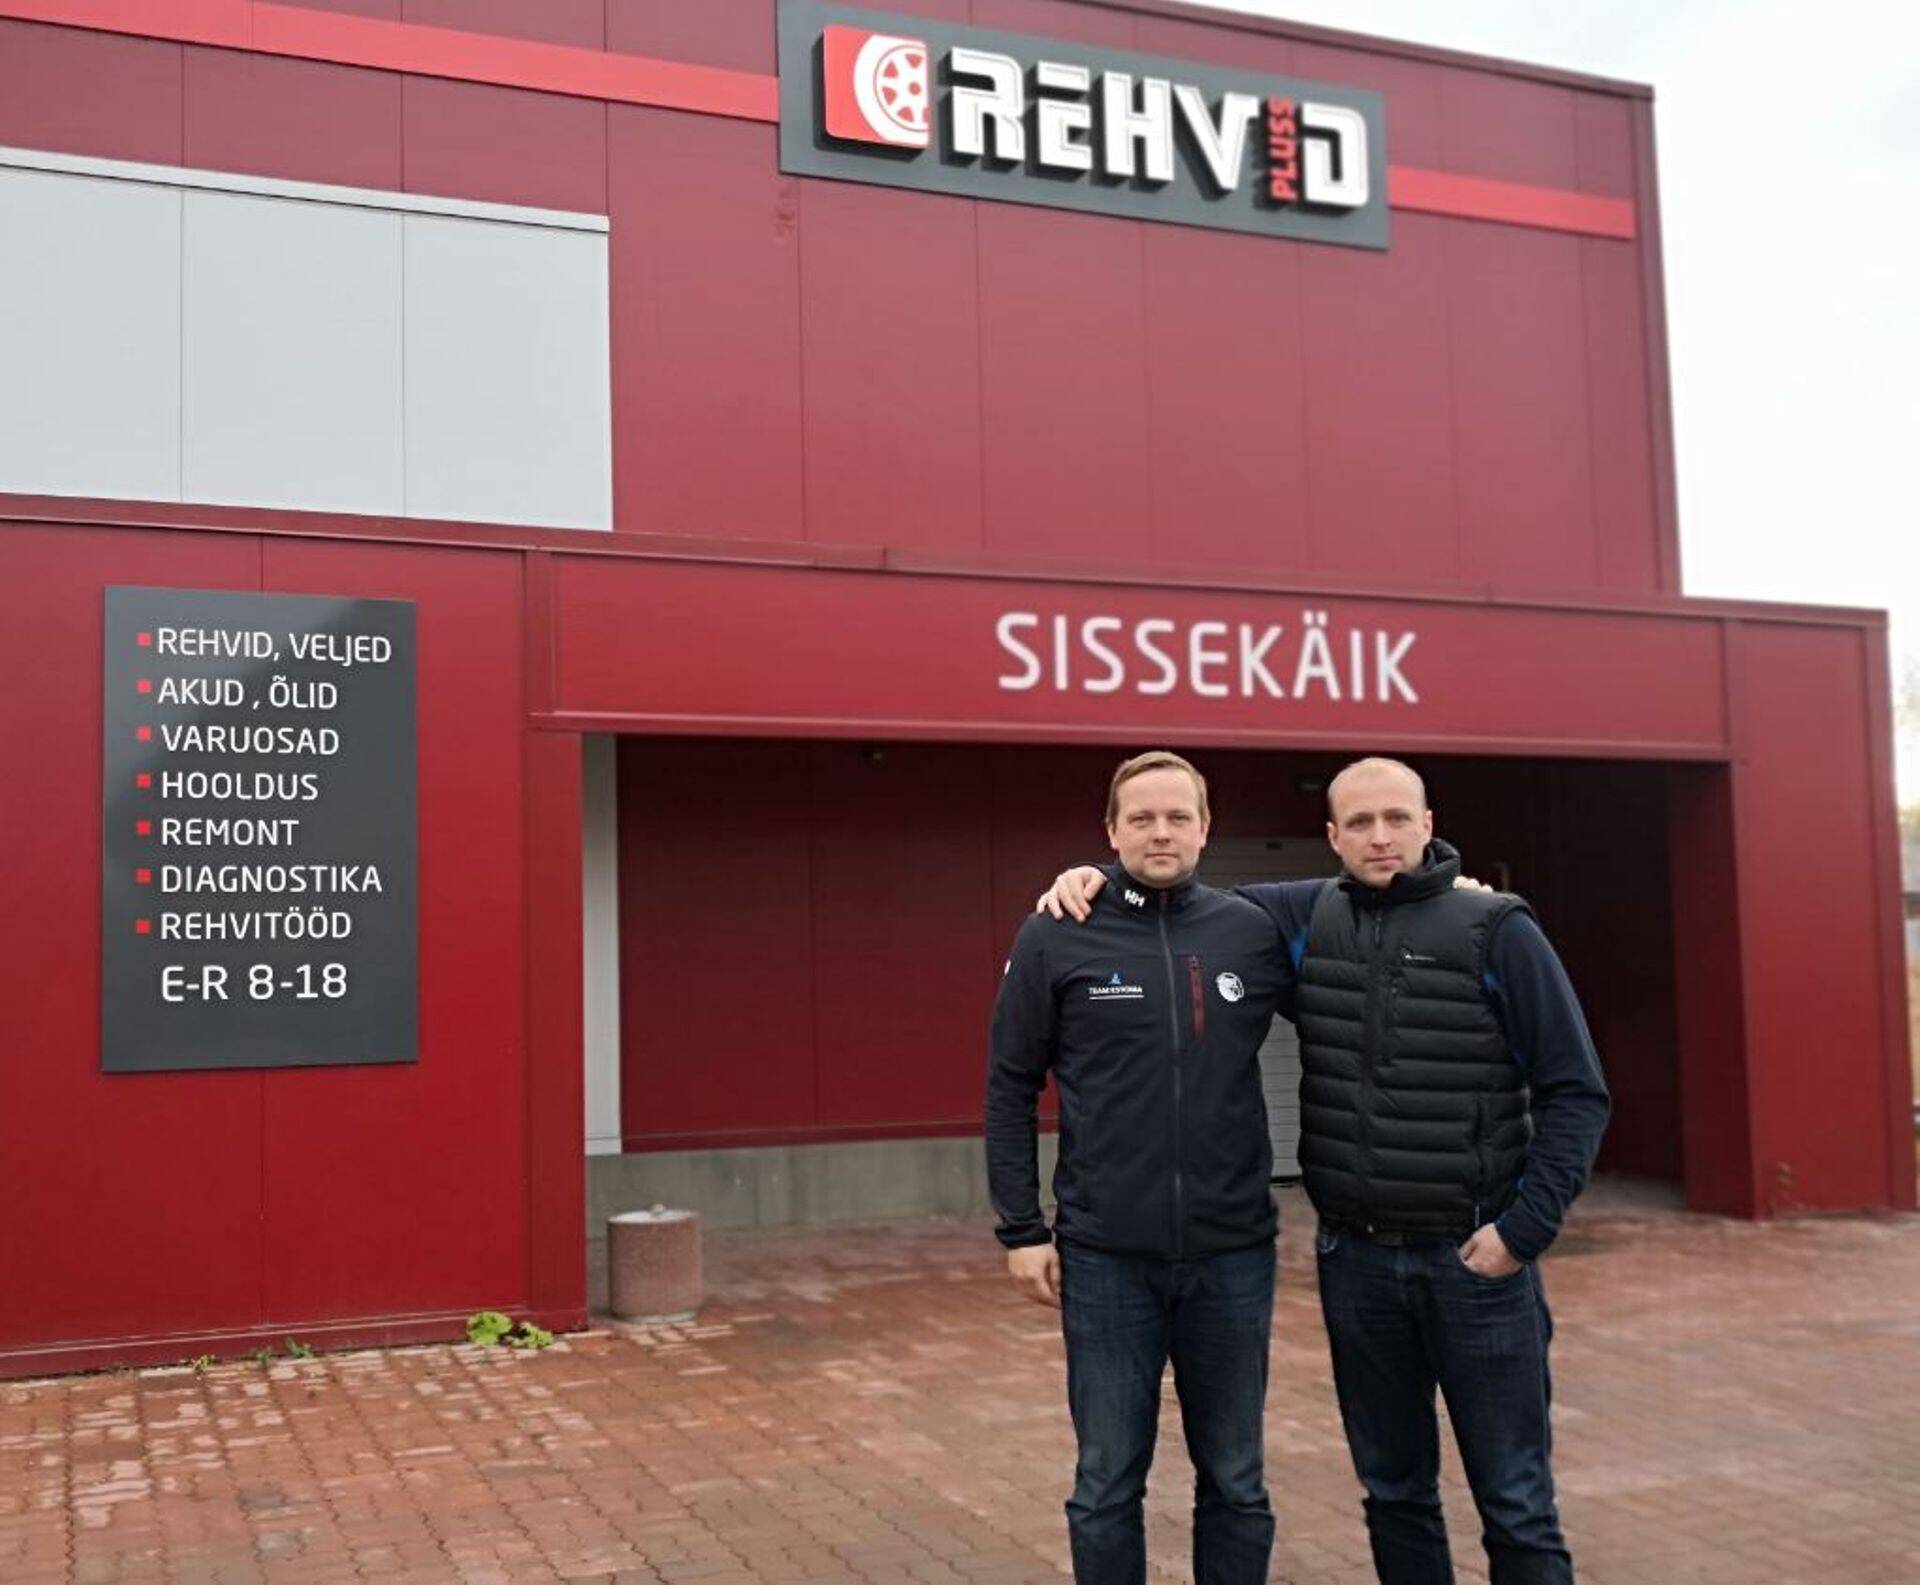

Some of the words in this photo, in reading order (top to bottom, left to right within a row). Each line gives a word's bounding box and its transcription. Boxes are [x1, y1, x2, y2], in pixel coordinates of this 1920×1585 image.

[1268, 97, 1297, 201] PLUSS
[157, 627, 281, 663] REHVID,
[288, 631, 392, 667] VELJED
[996, 610, 1418, 702] SISSEKÄIK
[157, 676, 244, 706] AKUD
[269, 674, 338, 709] ÕLID
[160, 723, 339, 756] VARUOSAD
[162, 771, 319, 801] HOOLDUS
[162, 817, 300, 846] REMONT
[161, 864, 383, 893] DIAGNOSTIKA
[161, 905, 351, 940] REHVITÖÖD
[162, 964, 229, 1002] E-R
[248, 962, 347, 1000] 8-18
